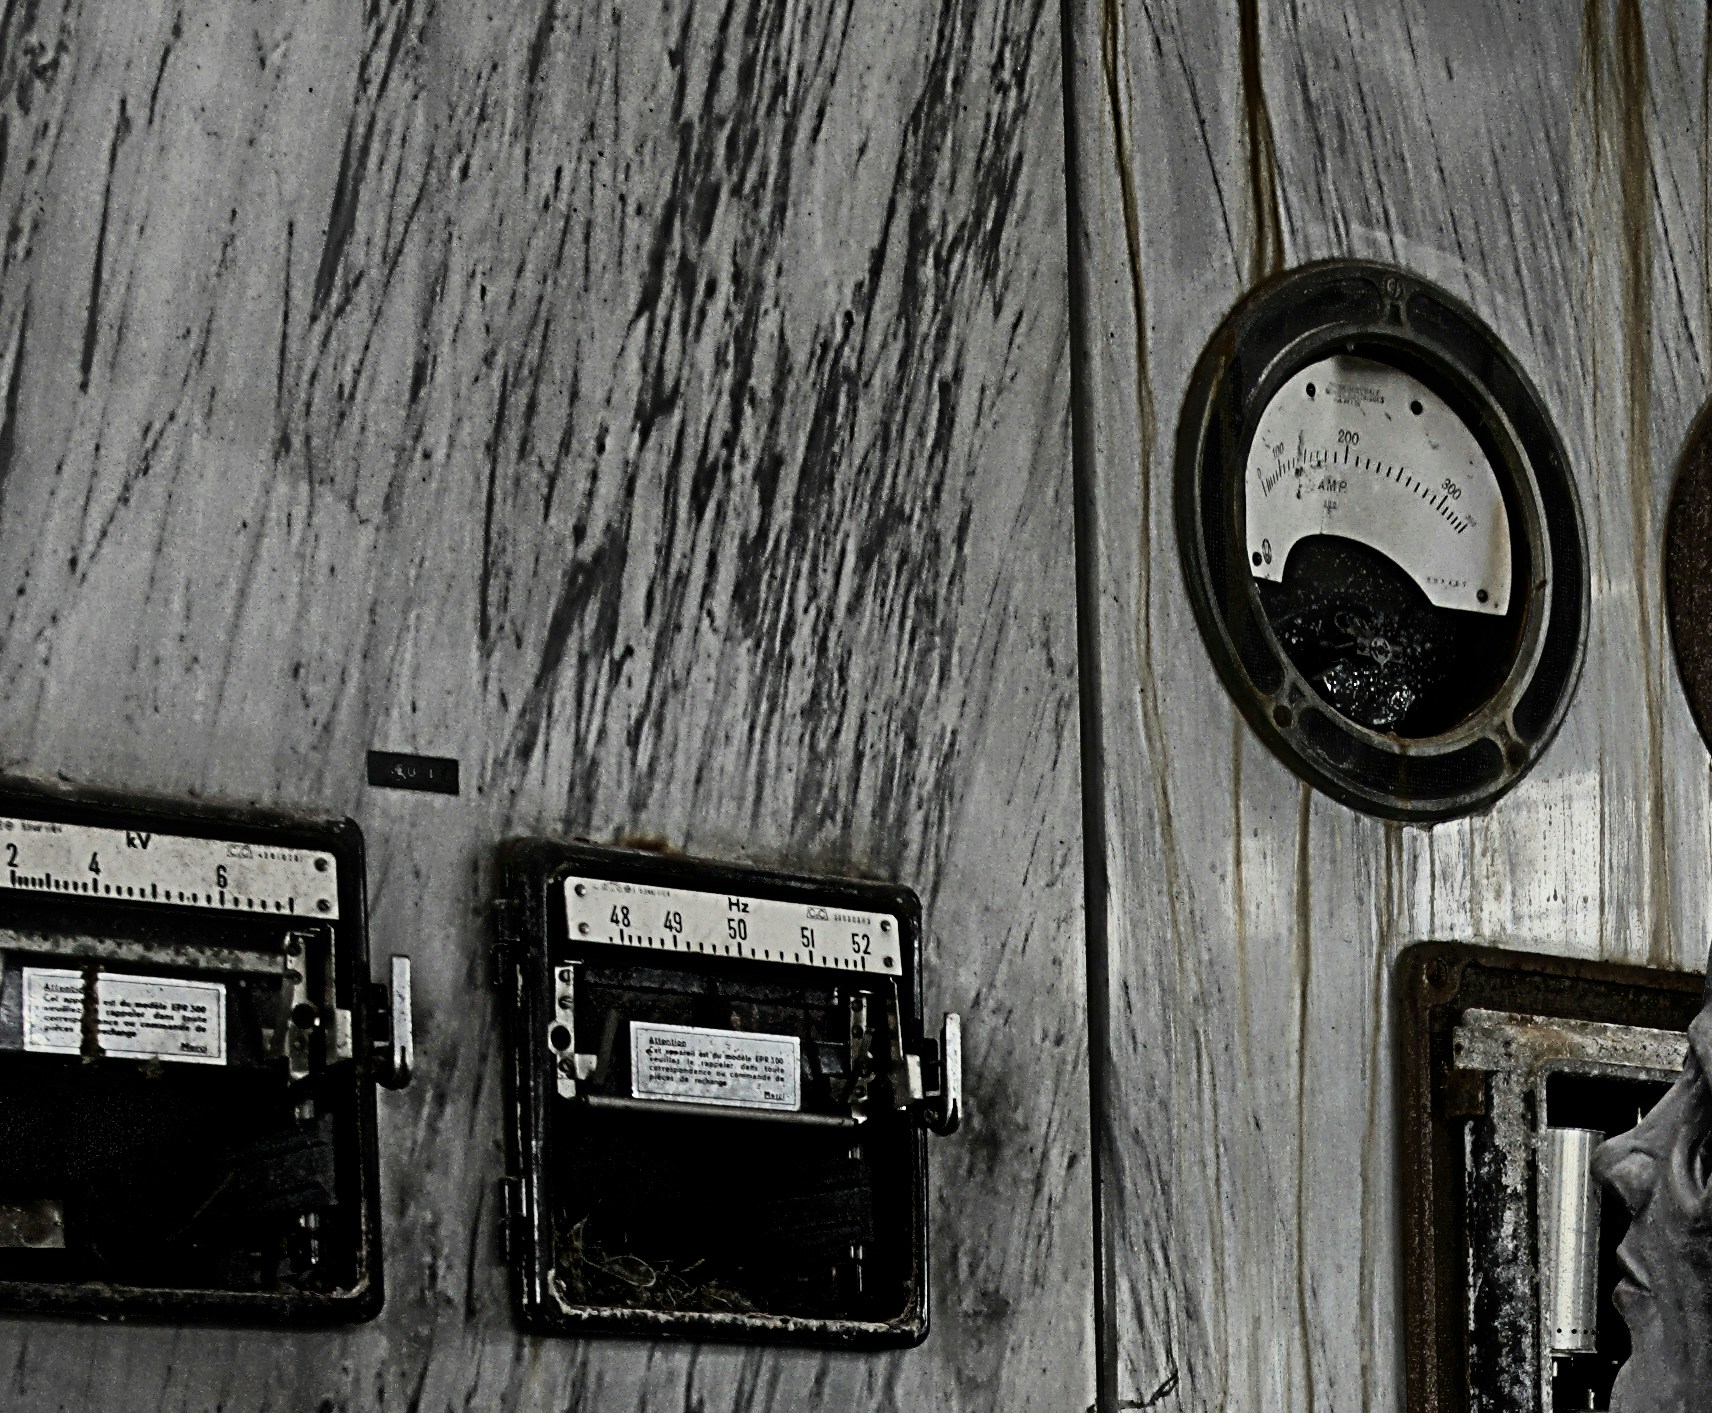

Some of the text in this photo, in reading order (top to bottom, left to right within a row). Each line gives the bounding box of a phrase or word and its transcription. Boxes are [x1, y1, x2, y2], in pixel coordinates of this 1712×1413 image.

[1338, 429, 1360, 446] 200
[1441, 478, 1462, 500] 300
[126, 829, 151, 849] kV
[6, 844, 19, 868] 2
[89, 852, 101, 875] 4
[216, 864, 229, 889] 6
[610, 905, 631, 928] 48
[728, 897, 749, 914] Hz
[664, 911, 683, 933] 49
[727, 919, 748, 941] 50
[801, 926, 816, 949] 51
[851, 934, 871, 955] 52
[649, 1036, 687, 1047] Attention
